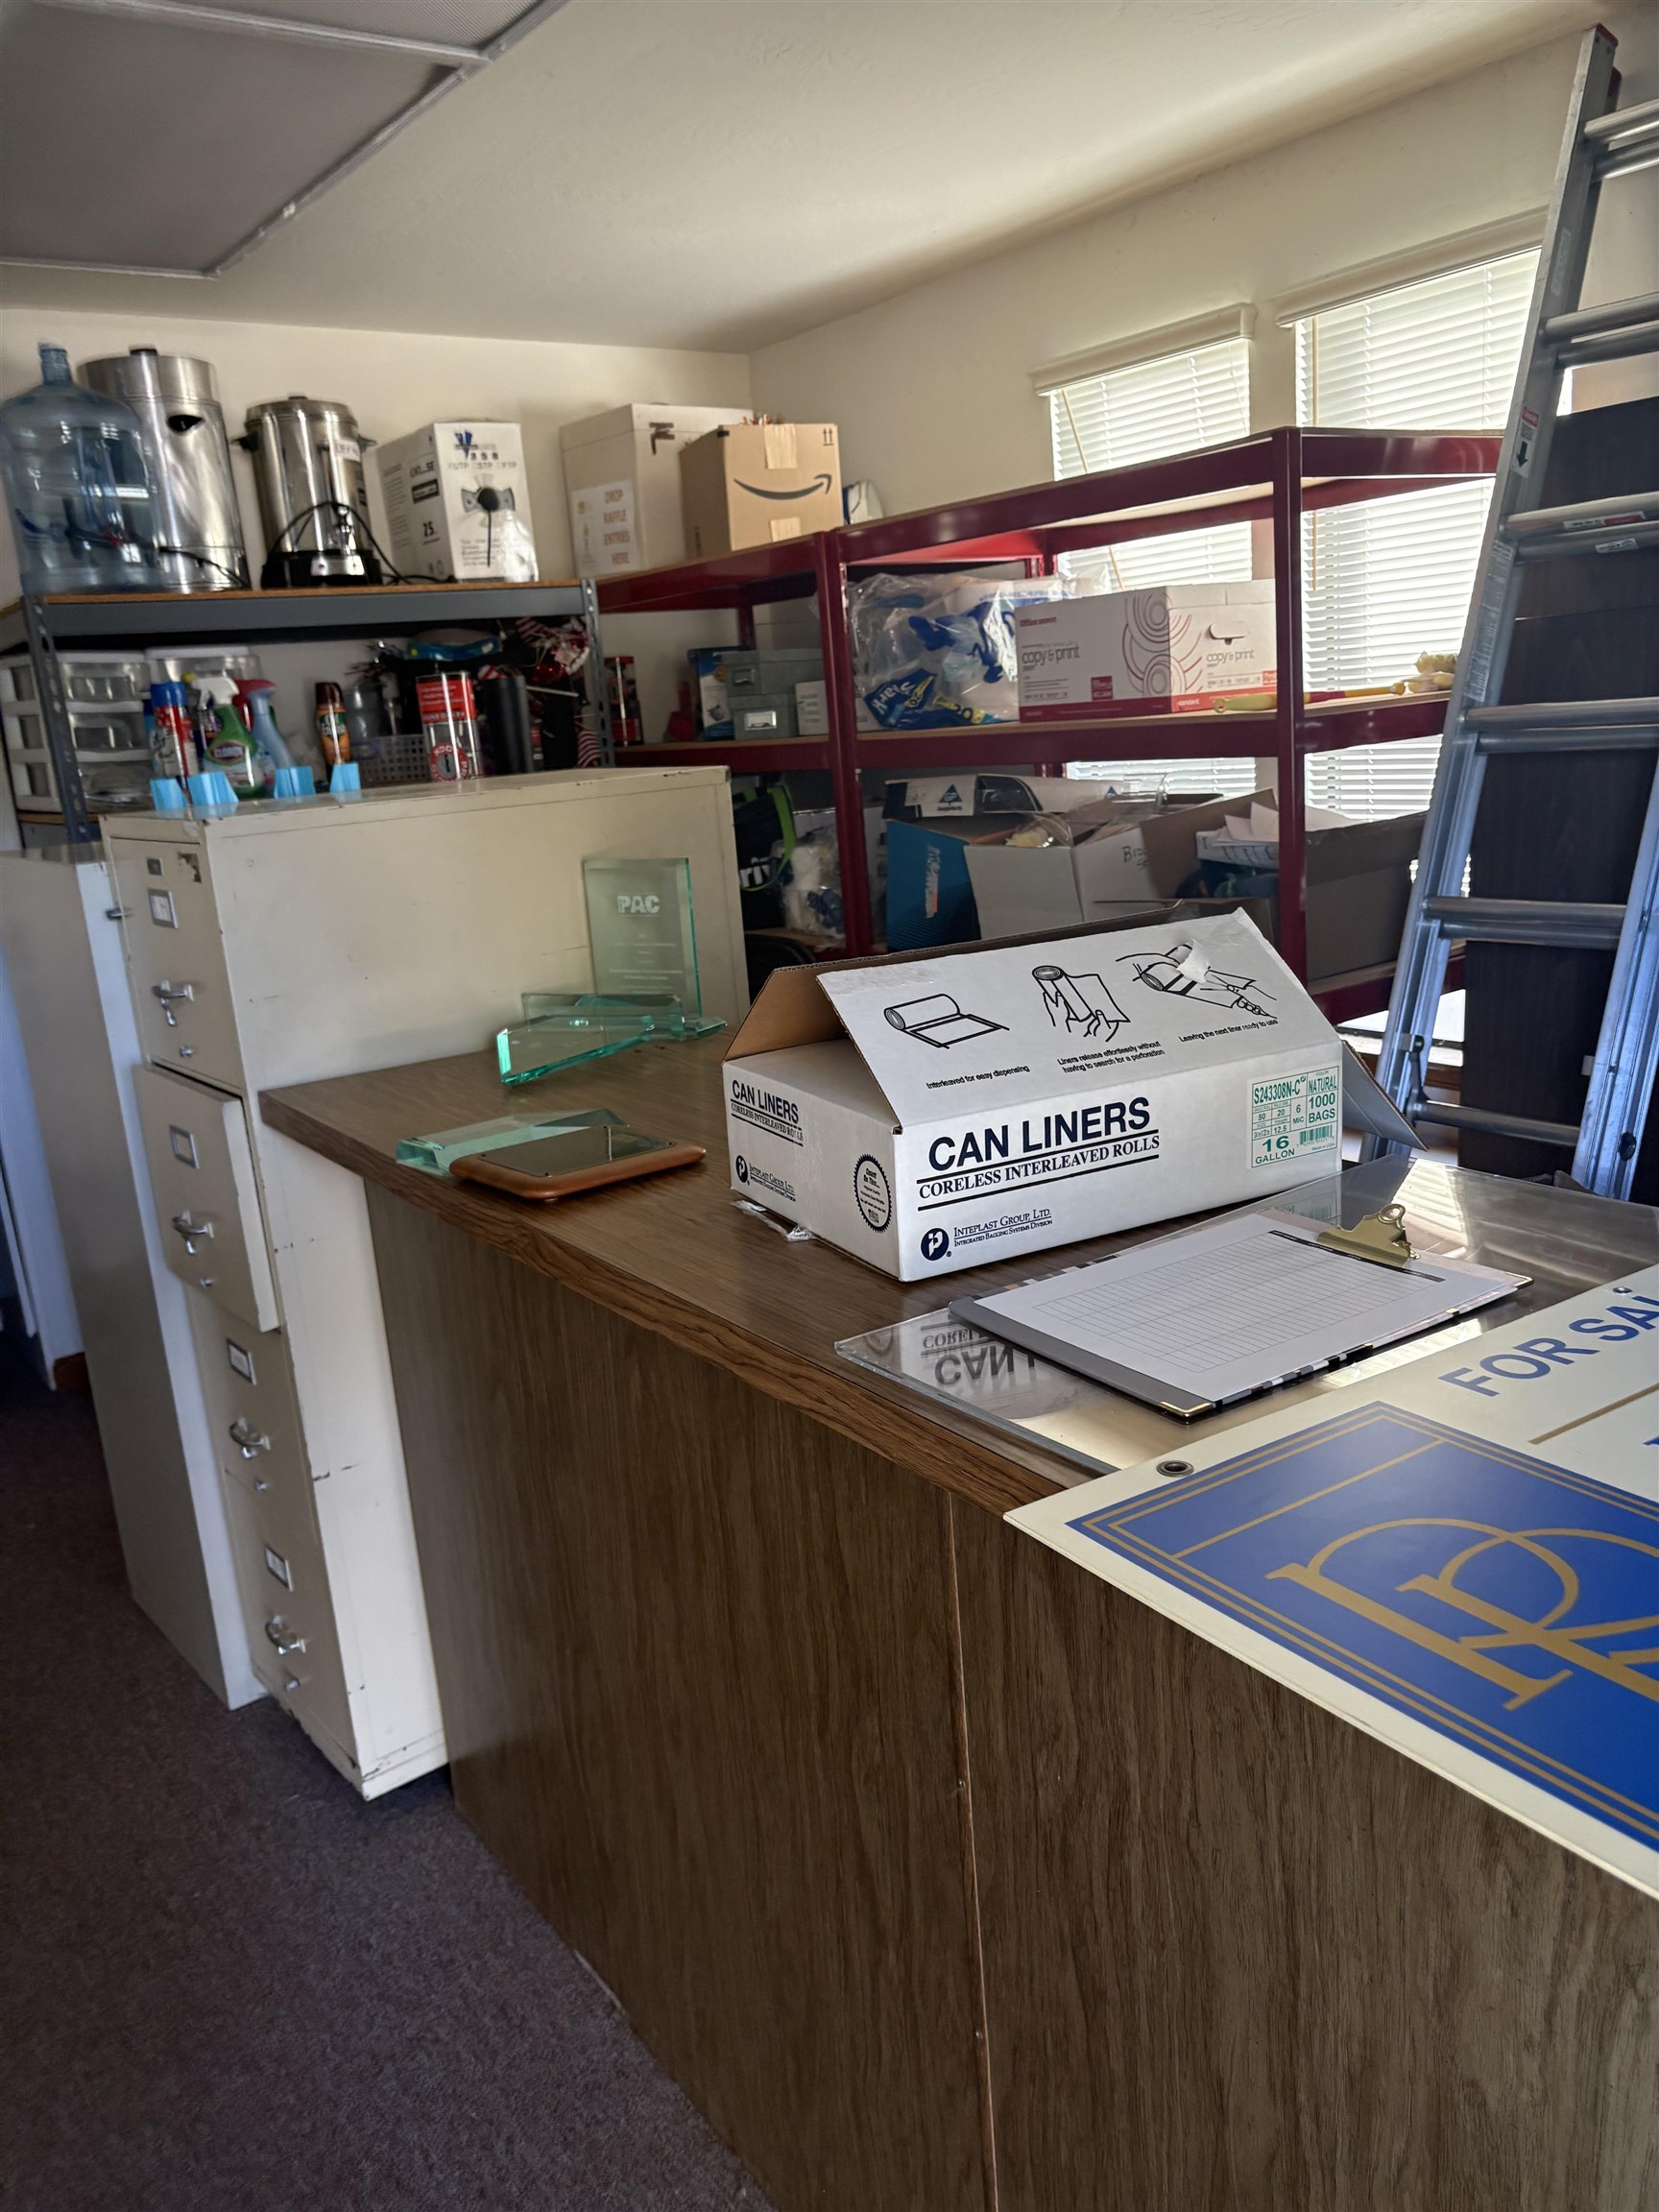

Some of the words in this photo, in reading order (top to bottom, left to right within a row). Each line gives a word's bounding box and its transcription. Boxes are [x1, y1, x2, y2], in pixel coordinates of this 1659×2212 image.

[1022, 649, 1046, 667] copy
[1056, 645, 1081, 664] print
[1206, 653, 1228, 664] copy
[1235, 649, 1255, 663] print
[616, 895, 661, 914] PAC
[1178, 1032, 1206, 1043] Leaving
[1214, 1027, 1230, 1036] next
[1227, 1024, 1242, 1034] liner
[1057, 1056, 1079, 1066] Liners
[1078, 1052, 1103, 1062] release
[1103, 1045, 1139, 1057] effortlessly
[1137, 1041, 1162, 1051] without
[1062, 1063, 1087, 1073] having
[1093, 1058, 1117, 1068] search
[1130, 1048, 1166, 1062] perforation
[926, 1075, 966, 1090] Interleaved
[964, 1074, 975, 1084] for
[975, 1071, 994, 1081] easy
[993, 1065, 1031, 1077] dispensing
[1308, 1075, 1337, 1094] NATURAL
[733, 1079, 756, 1106] CAN
[757, 1089, 799, 1124] LINERS
[1295, 1104, 1302, 1114] 6
[1309, 1092, 1335, 1110] 1000
[1258, 1113, 1266, 1121] 50
[1277, 1109, 1286, 1118] 20
[1292, 1116, 1305, 1124] MIC
[1308, 1108, 1335, 1123] BAGS
[928, 1124, 1009, 1171] CAN
[1022, 1096, 1151, 1154] LINERS
[1273, 1125, 1287, 1135] 12.5
[1262, 1135, 1289, 1153] 16
[1255, 1148, 1295, 1165] GALLON
[919, 1169, 1002, 1200] CORELESS
[1004, 1145, 1110, 1182] INTERLEAVED
[1112, 1135, 1161, 1158] ROLLS
[953, 1220, 998, 1238] INTEPLAST
[999, 1213, 1031, 1227] GROUP,
[1033, 1209, 1052, 1219] LTD.
[953, 1235, 985, 1247] INTEGRATED
[1030, 1219, 1053, 1230] DIVISION
[1438, 1337, 1600, 1397] FOR
